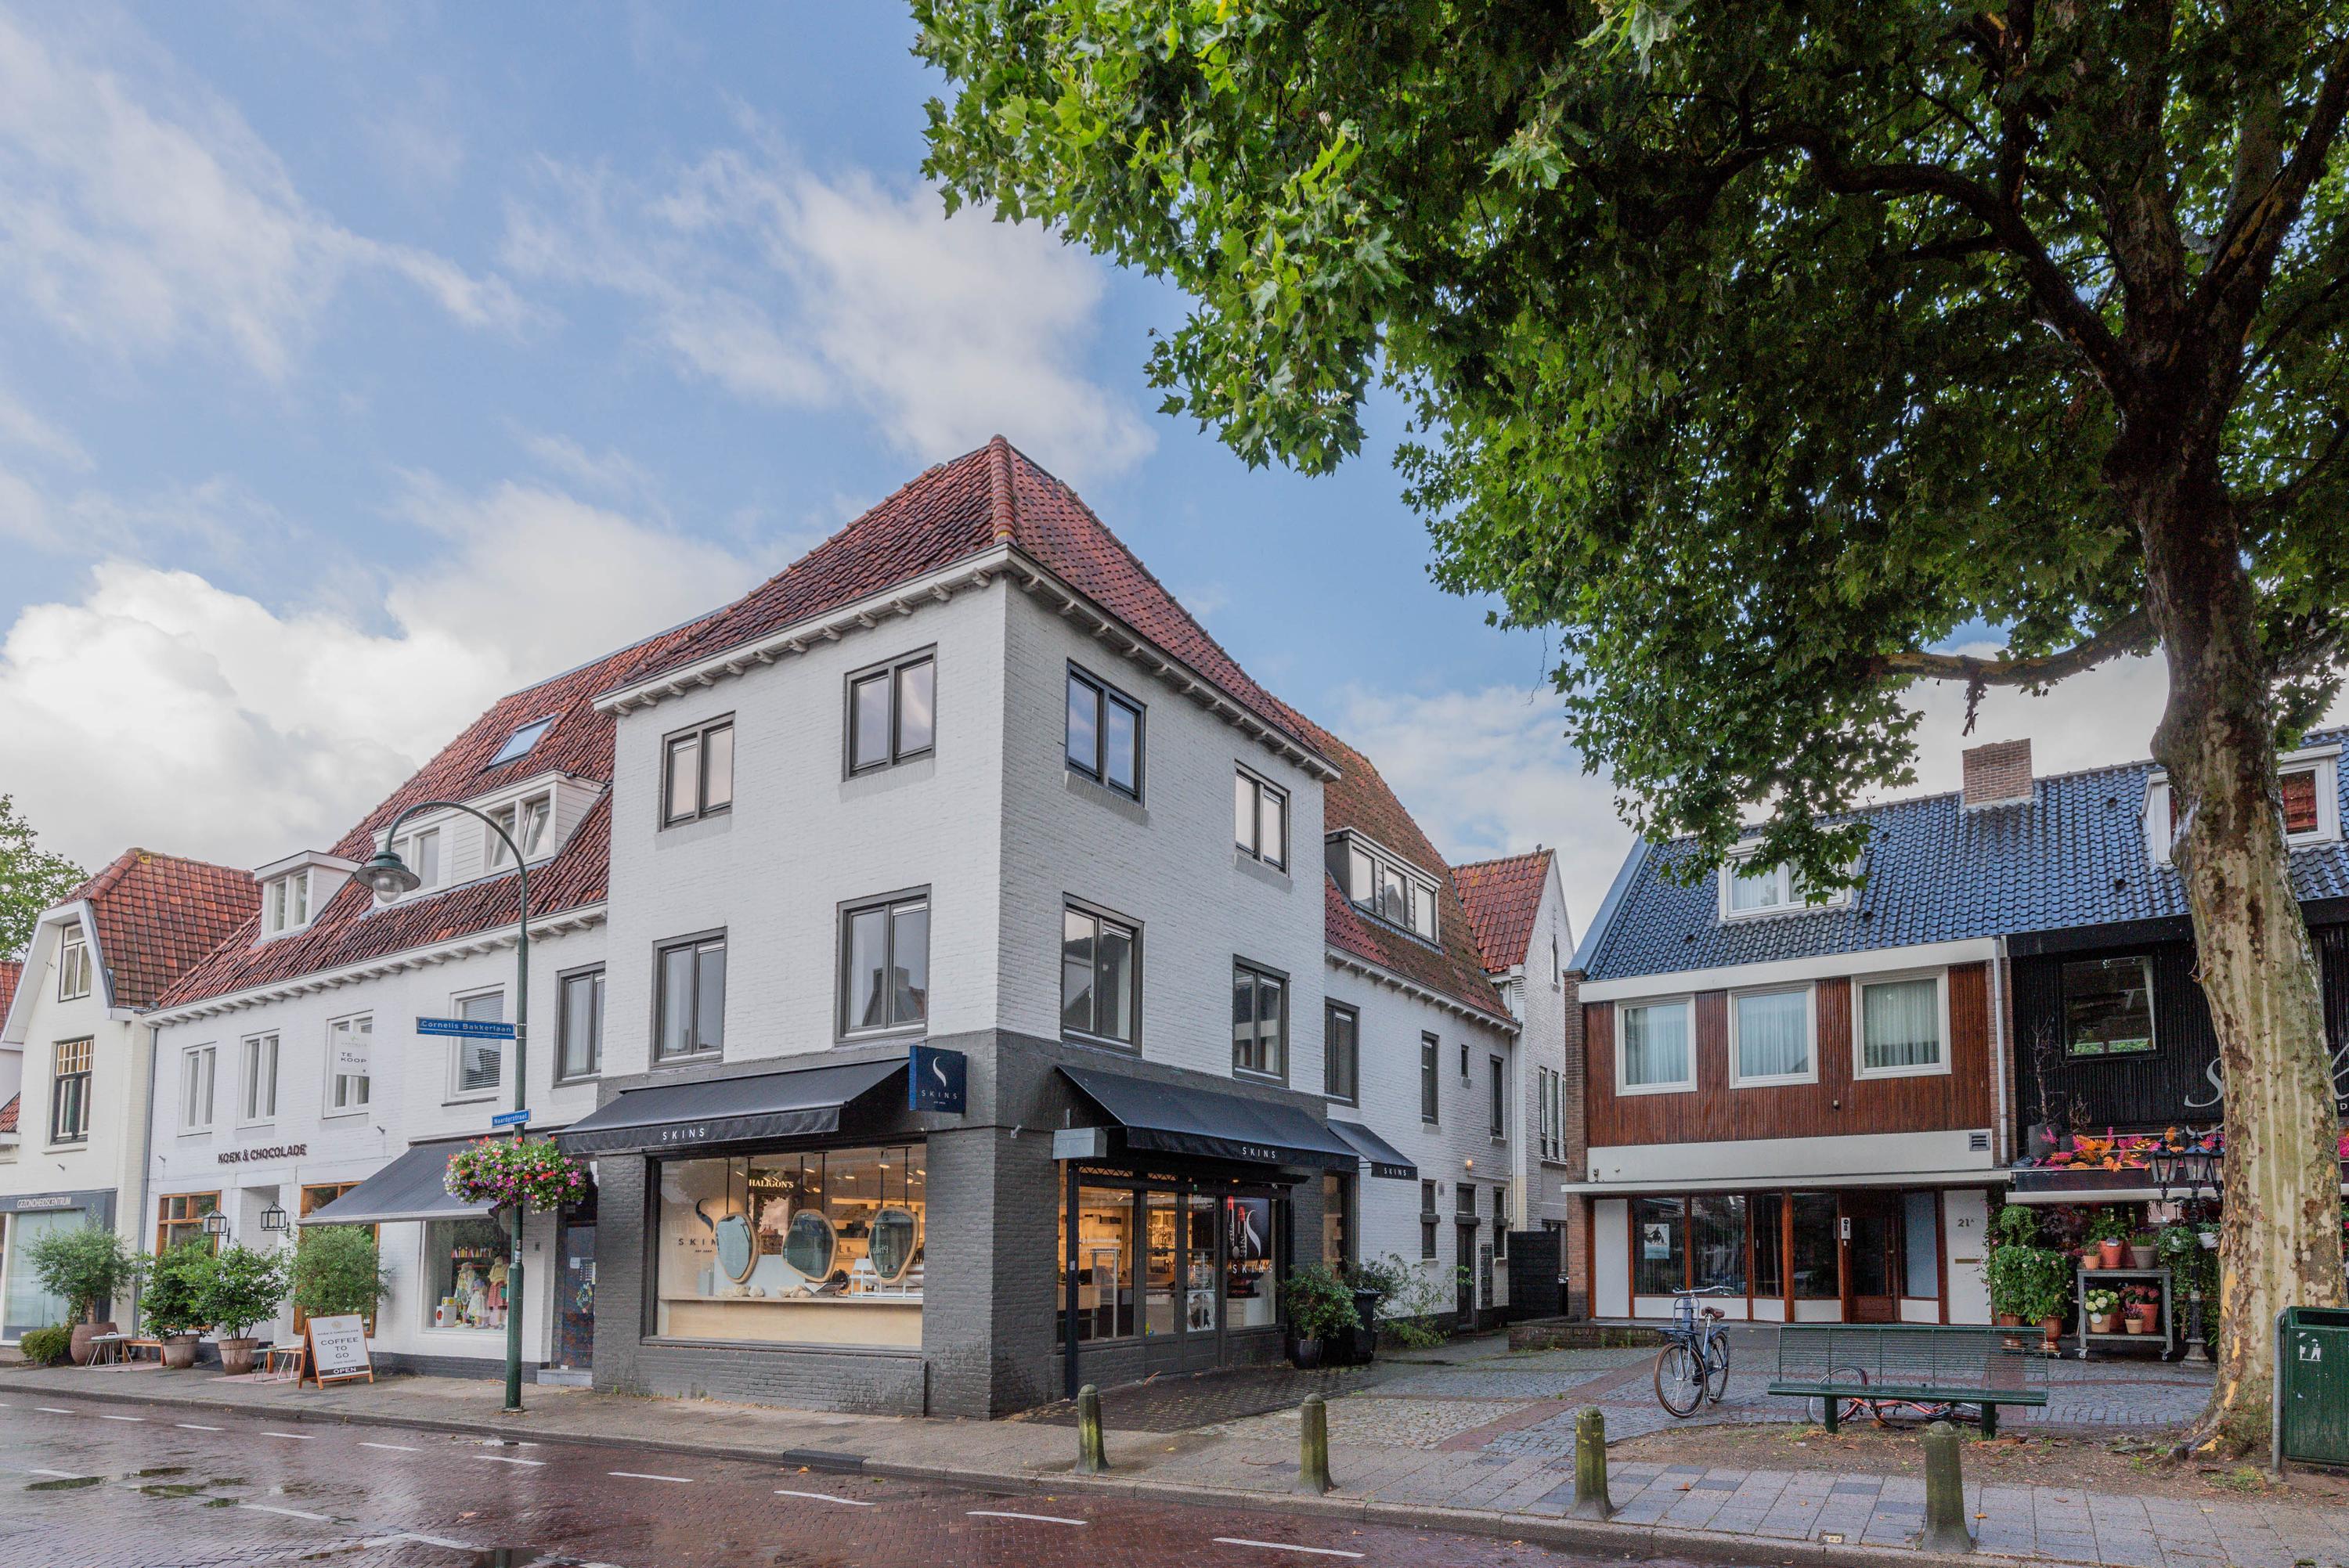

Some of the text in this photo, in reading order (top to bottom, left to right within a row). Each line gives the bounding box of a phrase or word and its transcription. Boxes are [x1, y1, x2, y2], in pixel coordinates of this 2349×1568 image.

[421, 1020, 511, 1033] Cornelis Bakkerlaan
[921, 1090, 958, 1100] SKINS
[494, 1112, 527, 1124] Naarderstraat
[662, 1127, 705, 1141] SKINS
[218, 1144, 307, 1165] KOEK & CHOCOLADE
[1242, 1146, 1276, 1159] SKINS
[1384, 1167, 1406, 1177] SKINS
[16, 1196, 71, 1208] GEZONDHEIDSCENTRUM
[678, 1238, 716, 1246] SKIN
[1232, 1263, 1273, 1274] SKINS
[320, 1336, 359, 1346] COFFEE
